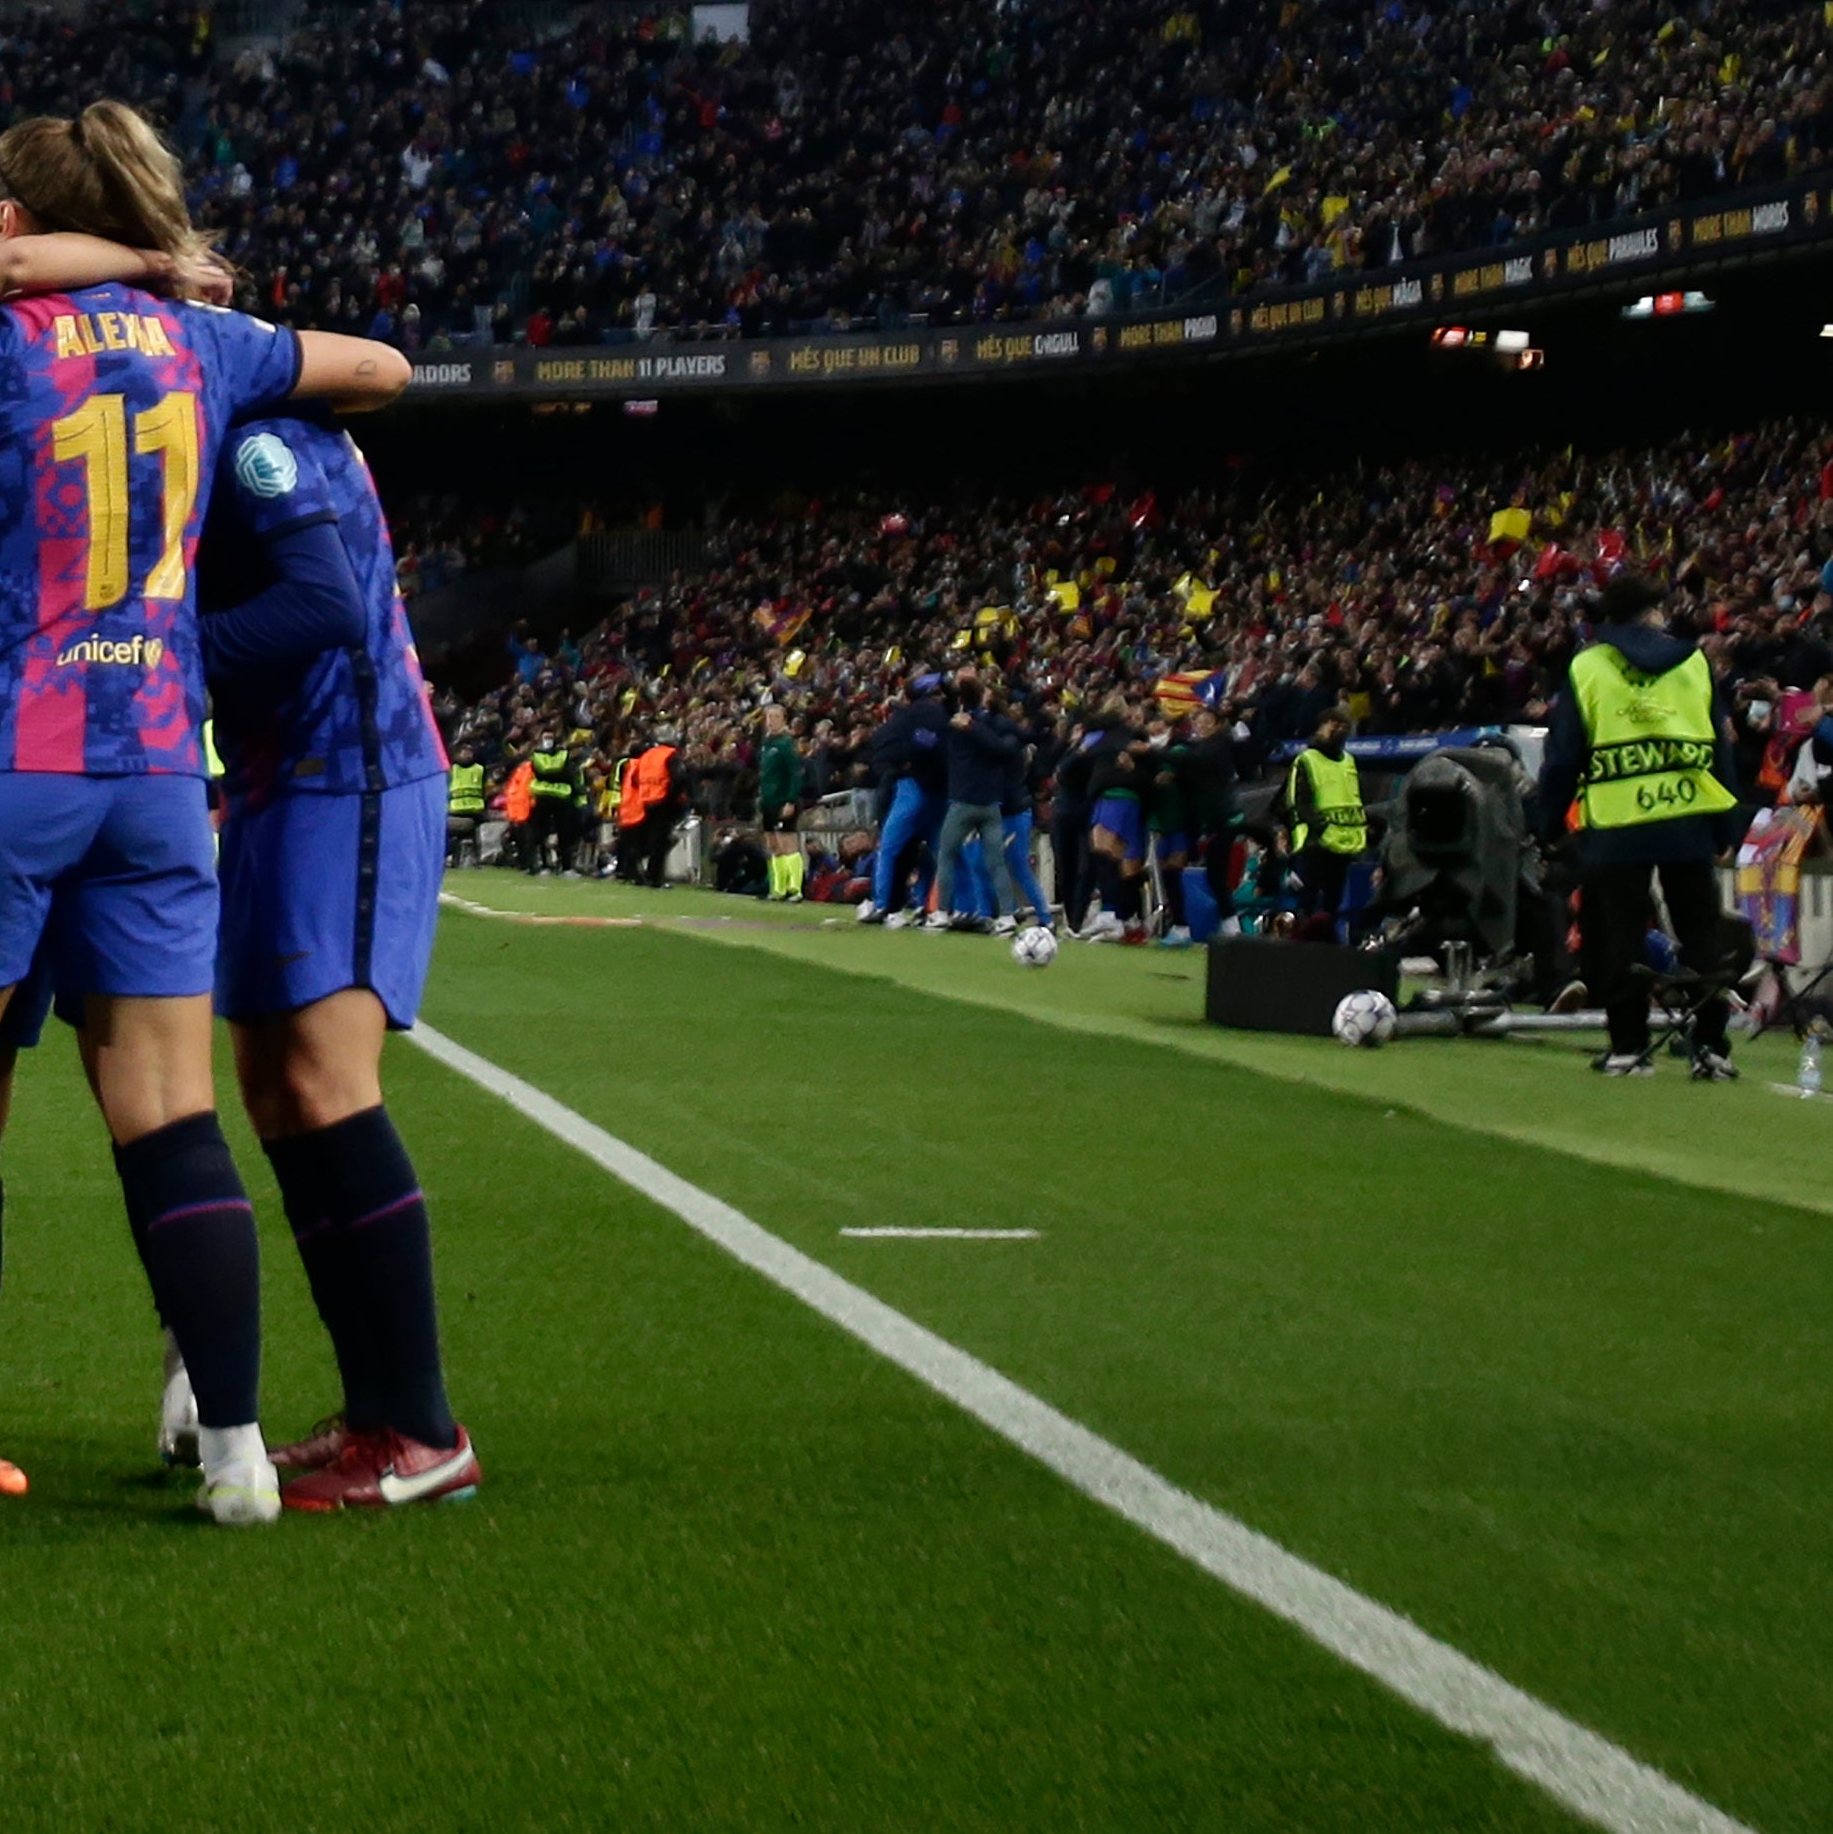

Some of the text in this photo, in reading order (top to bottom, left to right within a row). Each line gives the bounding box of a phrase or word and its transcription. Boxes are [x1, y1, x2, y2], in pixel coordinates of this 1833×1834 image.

[790, 345, 820, 371] MÉS
[823, 349, 856, 374] QUE
[884, 343, 921, 367] CLUB
[977, 333, 1003, 359] MÉS
[1005, 335, 1033, 361] QUE
[413, 363, 471, 384] ADORS
[537, 360, 584, 381] MORE
[590, 357, 634, 378] THAN
[656, 354, 726, 378] PLAYERS
[51, 391, 200, 610] 11
[57, 632, 143, 667] unicef
[1589, 741, 1714, 782] STEWARD
[1637, 776, 1695, 811] 640
